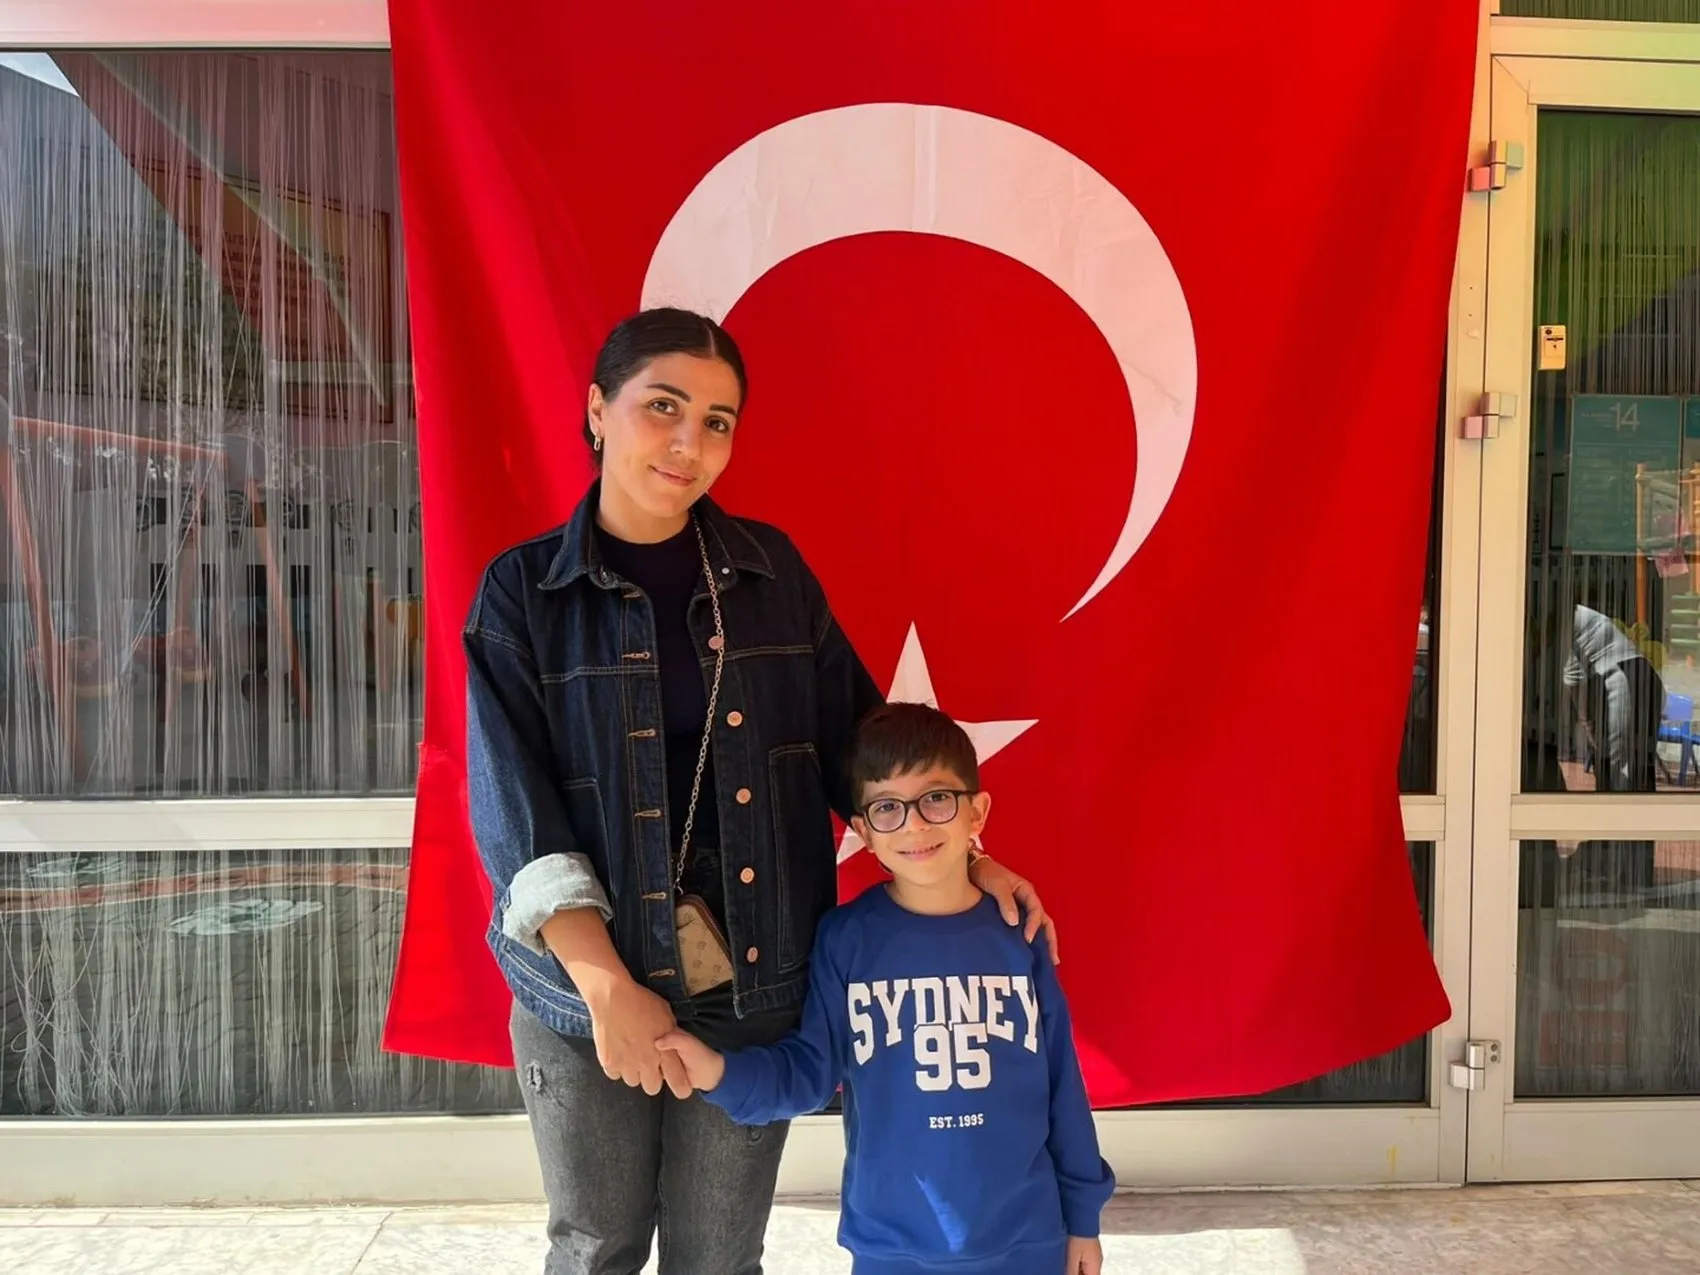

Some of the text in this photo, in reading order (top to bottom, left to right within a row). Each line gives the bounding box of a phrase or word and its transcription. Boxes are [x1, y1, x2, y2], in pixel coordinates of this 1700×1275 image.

[1610, 403, 1640, 431] 14
[848, 976, 1039, 1066] SYDNEY
[914, 1023, 991, 1091] 95
[929, 1113, 984, 1128] EST. 1995
